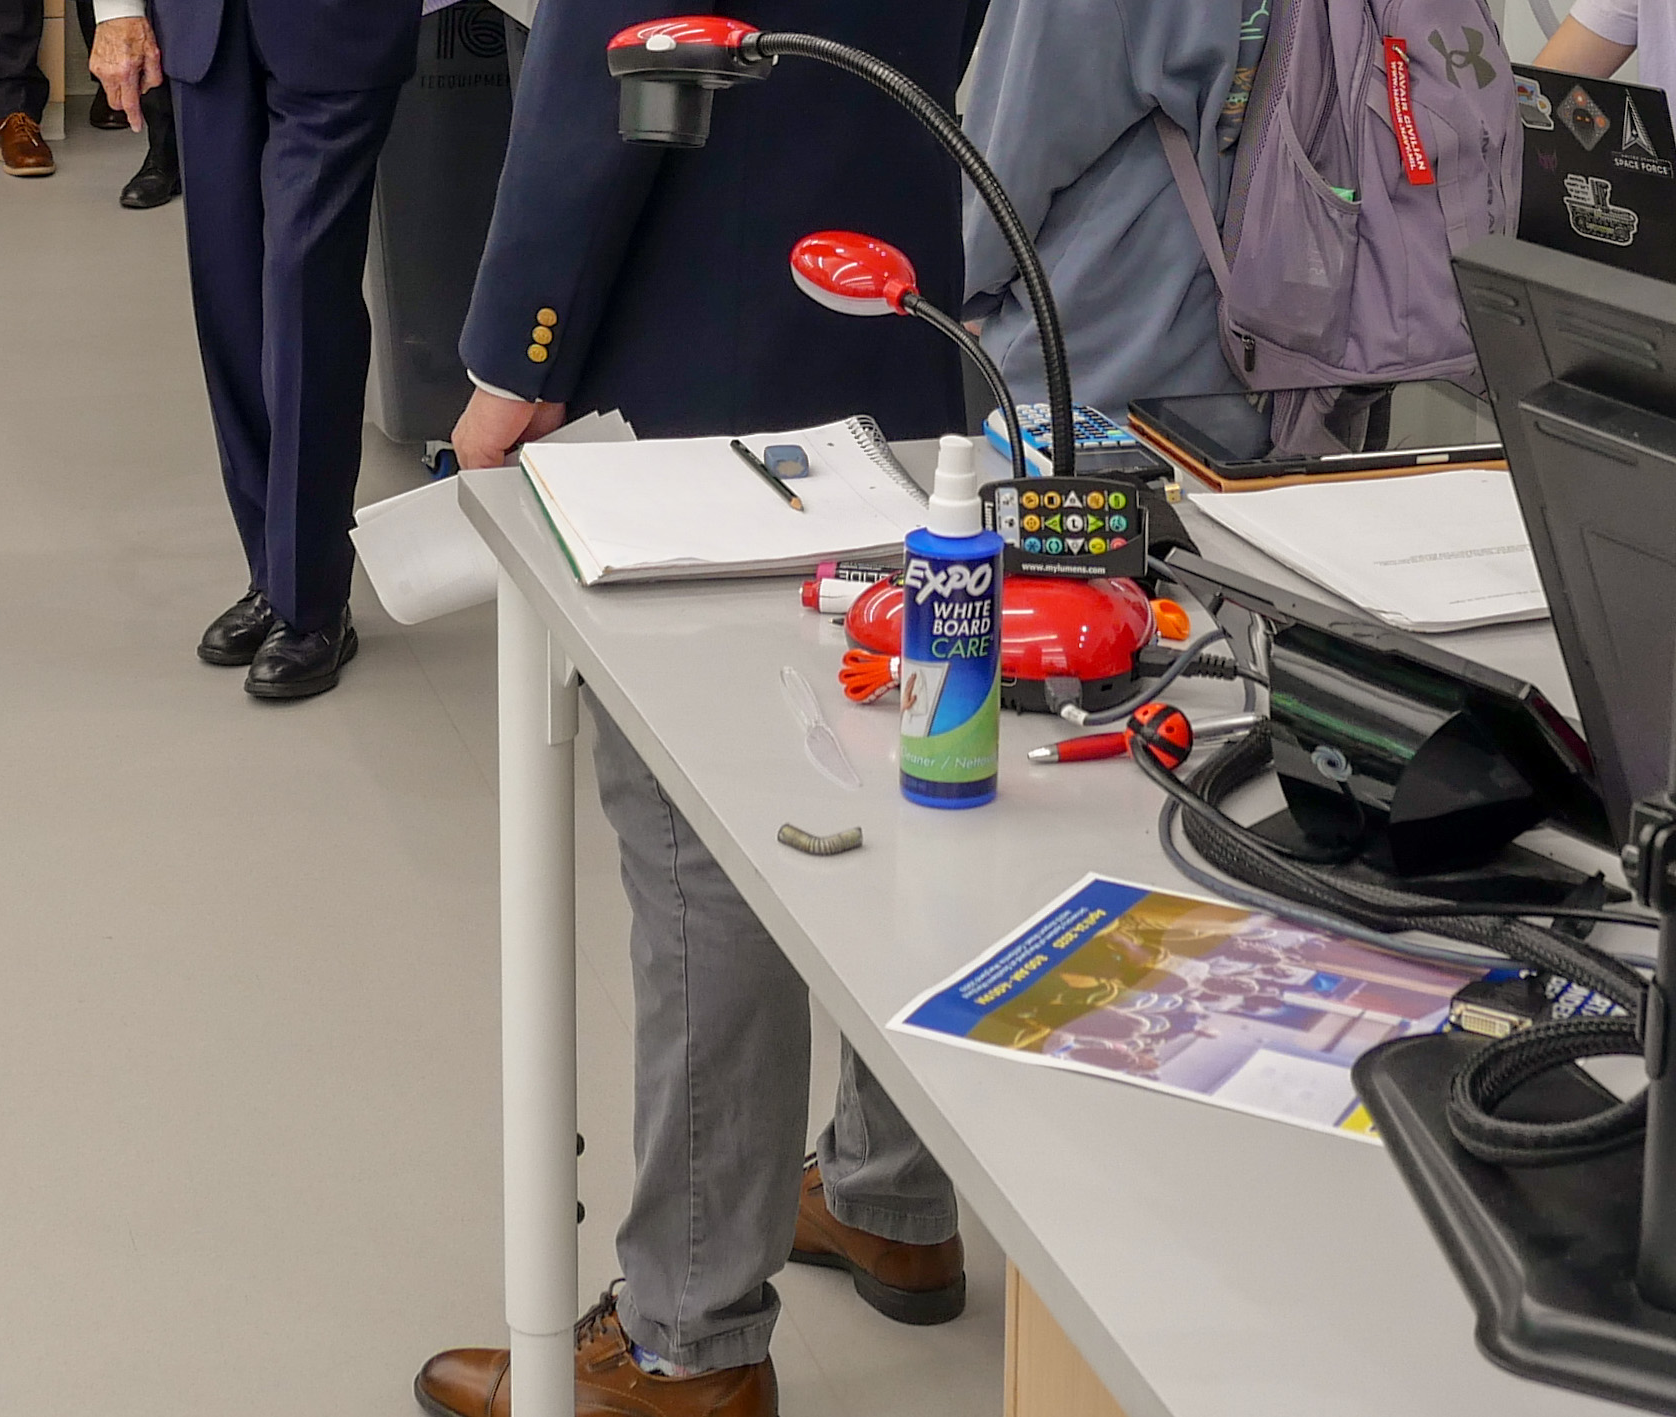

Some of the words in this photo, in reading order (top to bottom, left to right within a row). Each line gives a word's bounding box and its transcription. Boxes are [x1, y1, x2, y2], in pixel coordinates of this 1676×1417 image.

[1396, 60, 1409, 112] NAVAIR
[1403, 114, 1426, 171] CIVILIAN
[1613, 157, 1640, 171] SPACE
[1640, 162, 1669, 176] FORCE
[1021, 562, 1106, 575] www.mylumens.com
[905, 558, 993, 605] EXPO
[933, 599, 992, 620] WHITE
[933, 617, 992, 637] BOARD
[932, 635, 991, 660] CARE
